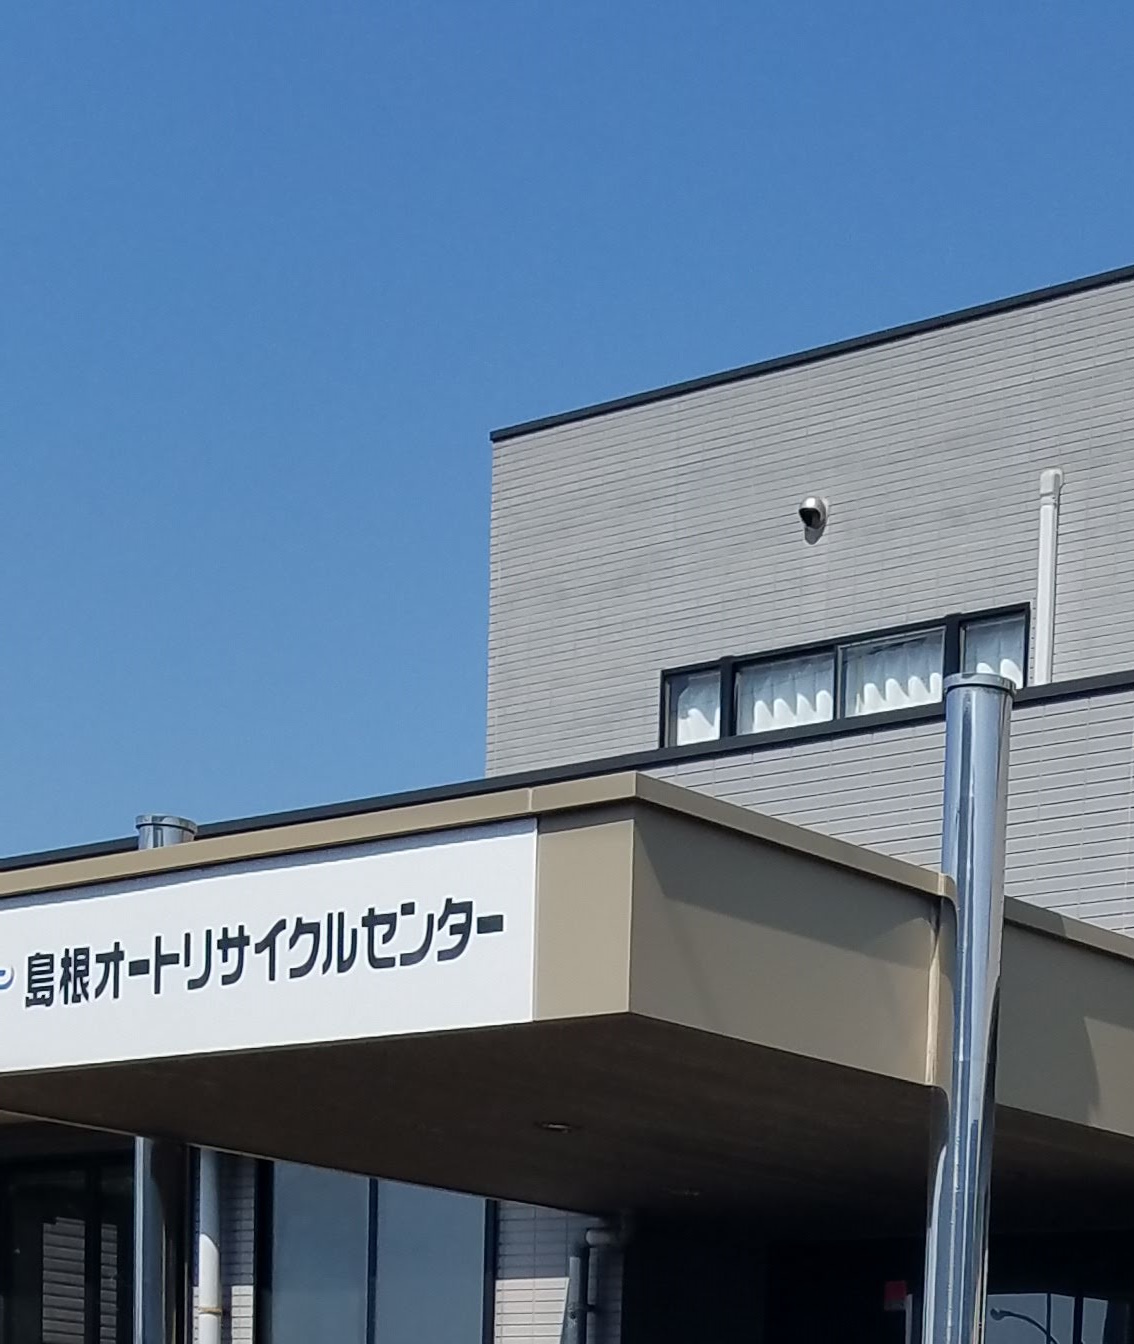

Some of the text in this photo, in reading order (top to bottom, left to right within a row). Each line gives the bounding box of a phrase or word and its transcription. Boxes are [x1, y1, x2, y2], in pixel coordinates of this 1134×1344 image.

[25, 897, 504, 1007] 島根オートリサイクルセンター
